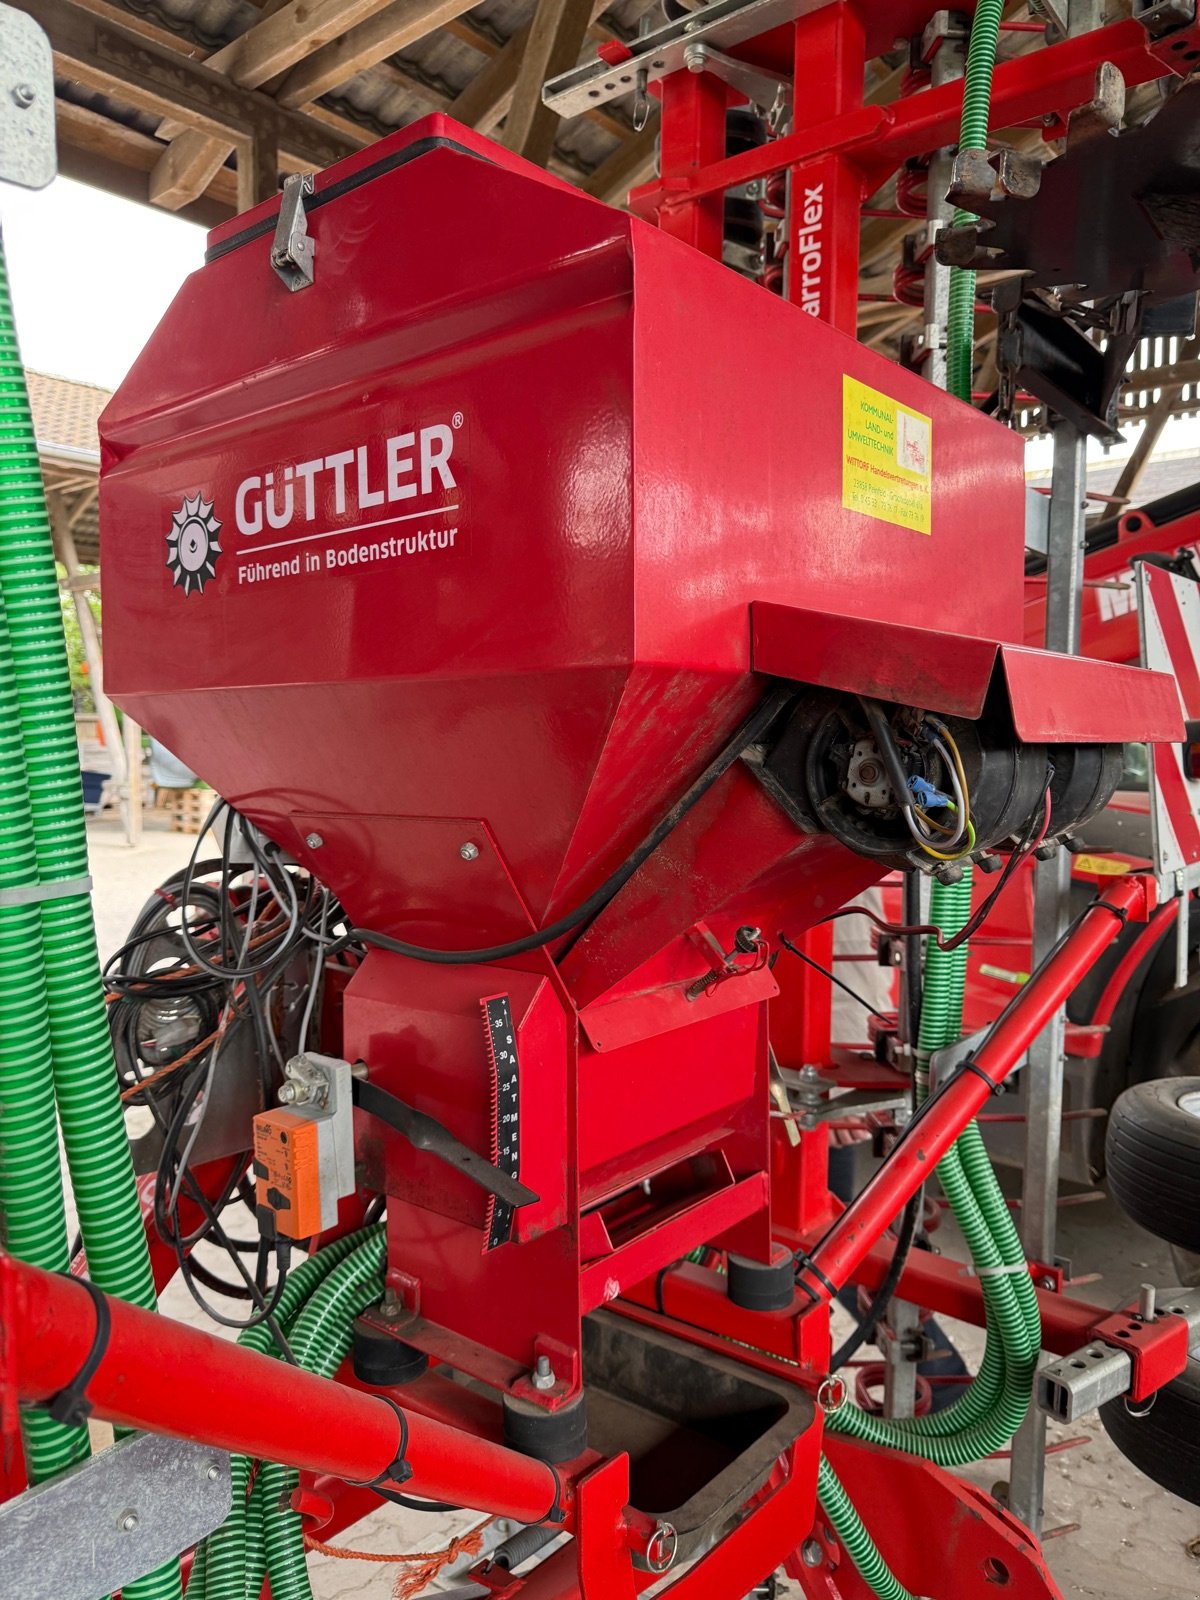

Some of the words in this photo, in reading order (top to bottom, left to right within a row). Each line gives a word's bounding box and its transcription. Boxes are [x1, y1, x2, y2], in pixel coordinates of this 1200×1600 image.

[860, 401, 894, 424] KOMMUNAL-
[865, 419, 883, 434] LAND-
[884, 430, 894, 440] und
[847, 429, 894, 456] UMWELTTECHNIK
[238, 555, 300, 585] Führend
[305, 552, 320, 573] in
[326, 528, 458, 569] Bodenstruktur
[494, 1019, 503, 1028] 35
[499, 1050, 508, 1060] 30
[502, 1082, 511, 1092] 25
[502, 1114, 511, 1124] 20
[503, 1146, 510, 1156] 15
[497, 1209, 502, 1217] 5
